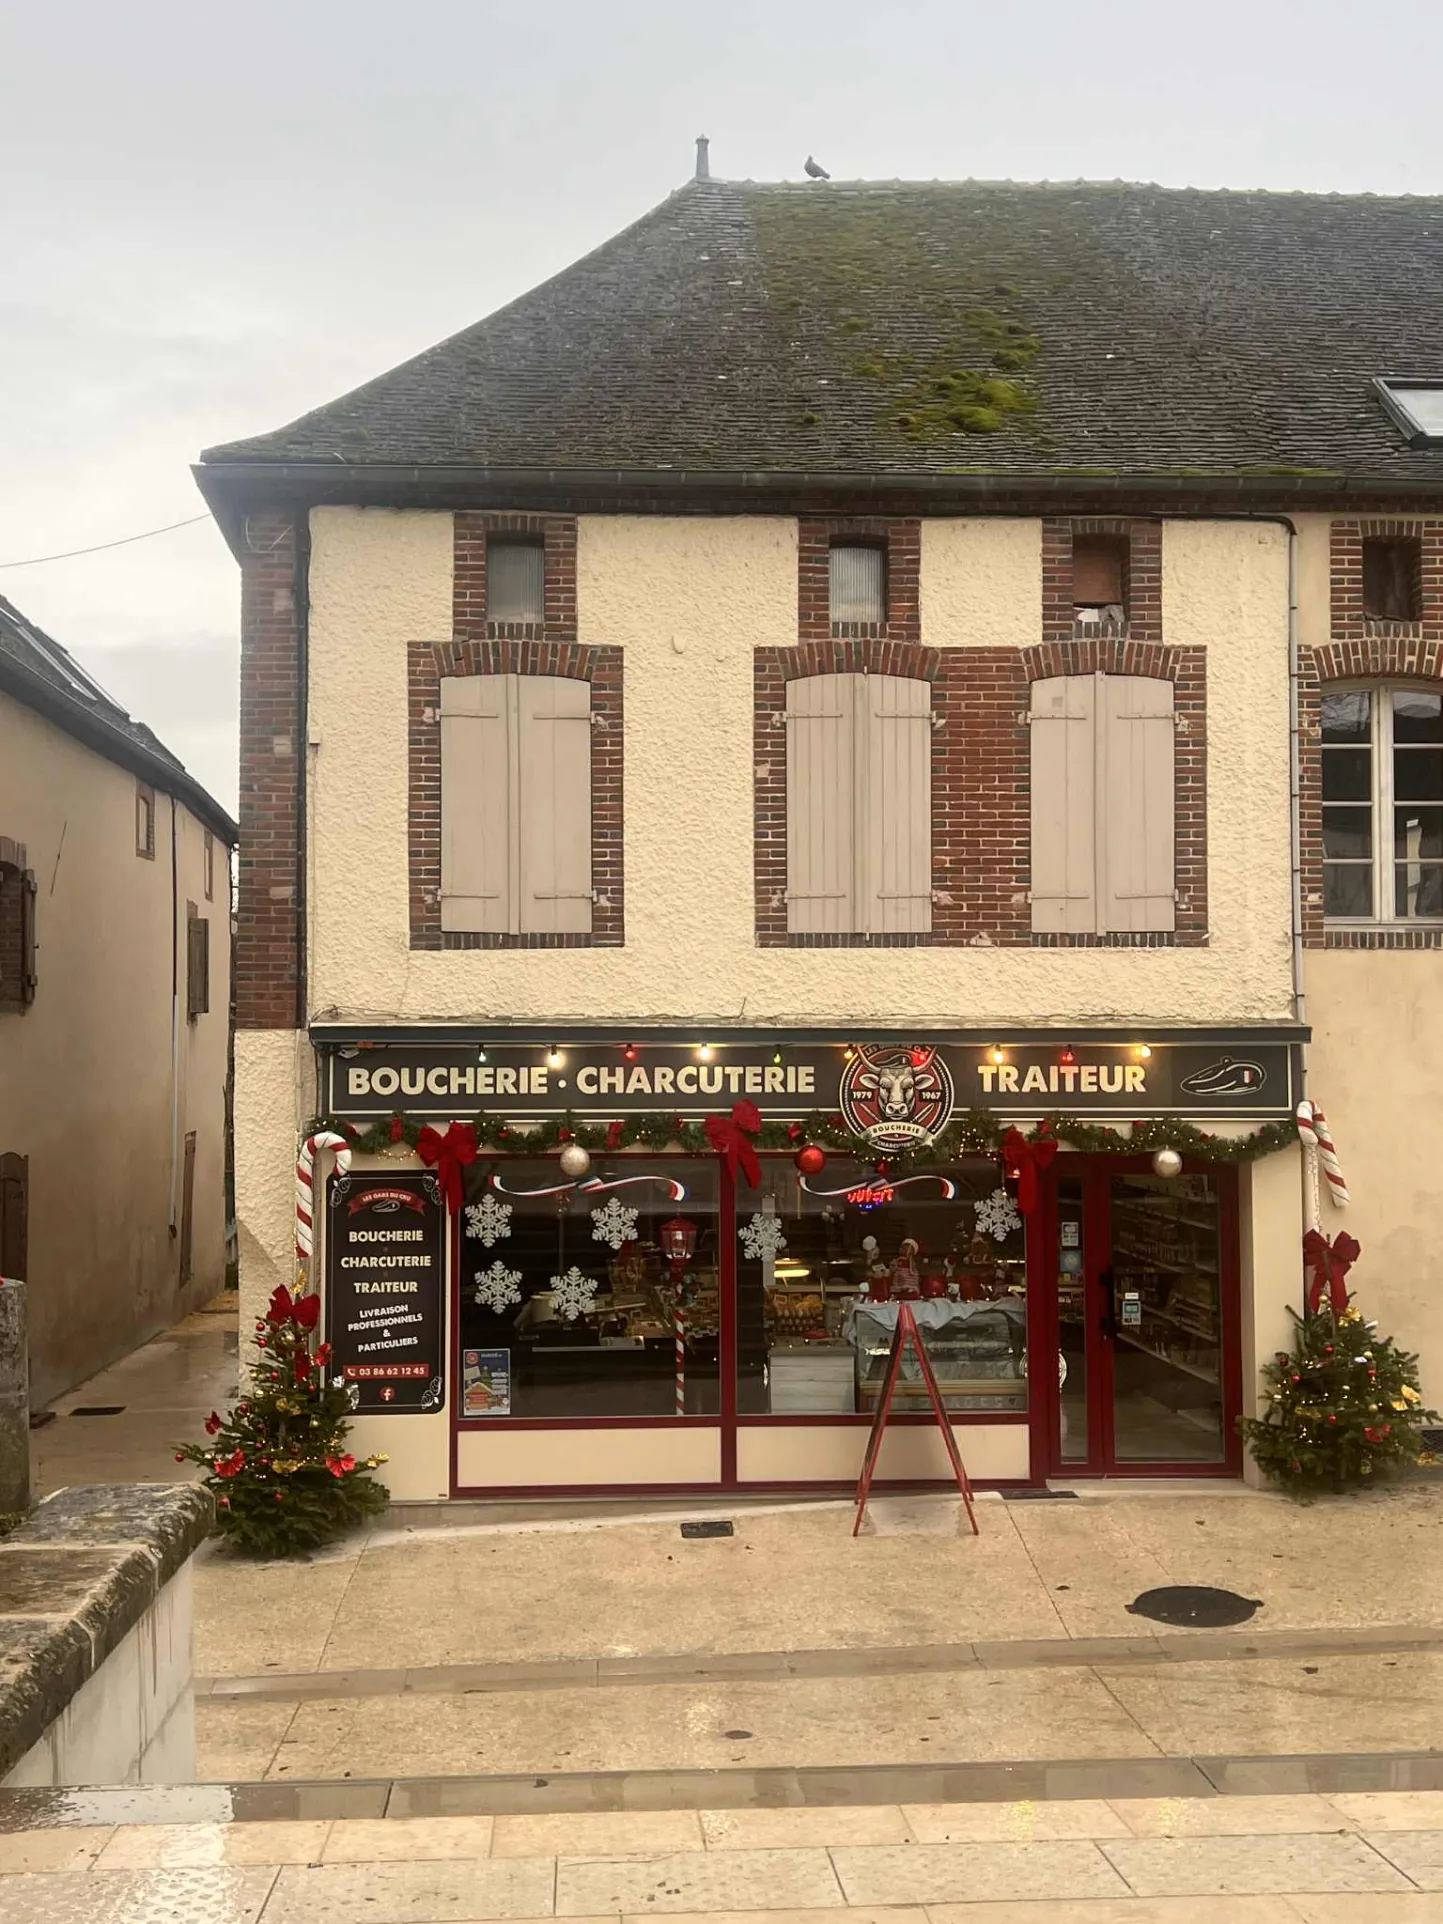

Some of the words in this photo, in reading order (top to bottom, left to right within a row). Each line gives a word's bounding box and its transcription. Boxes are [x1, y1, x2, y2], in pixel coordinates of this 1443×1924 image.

[348, 1066, 548, 1095] BOUCHERIE
[577, 1065, 815, 1094] CHARCUTERIE
[978, 1065, 1146, 1093] TRAITEUR
[853, 1091, 873, 1099] 1979
[922, 1091, 942, 1100] 1967
[872, 1124, 920, 1134] BOUCHERIE
[362, 1194, 373, 1202] LES
[349, 1230, 424, 1242] BOUCHERIE
[341, 1256, 432, 1268] CHARCUTERIE
[354, 1281, 418, 1293] TRAITEUR
[359, 1304, 409, 1318] LIVRAISON
[347, 1313, 423, 1332] PROFESSIONNELS
[383, 1328, 391, 1338] &
[357, 1336, 418, 1352] PARTICULIERS
[359, 1368, 371, 1376] 03
[373, 1368, 385, 1376] 86
[387, 1368, 398, 1376] 62
[401, 1367, 411, 1375] 12
[413, 1367, 425, 1375] 45
